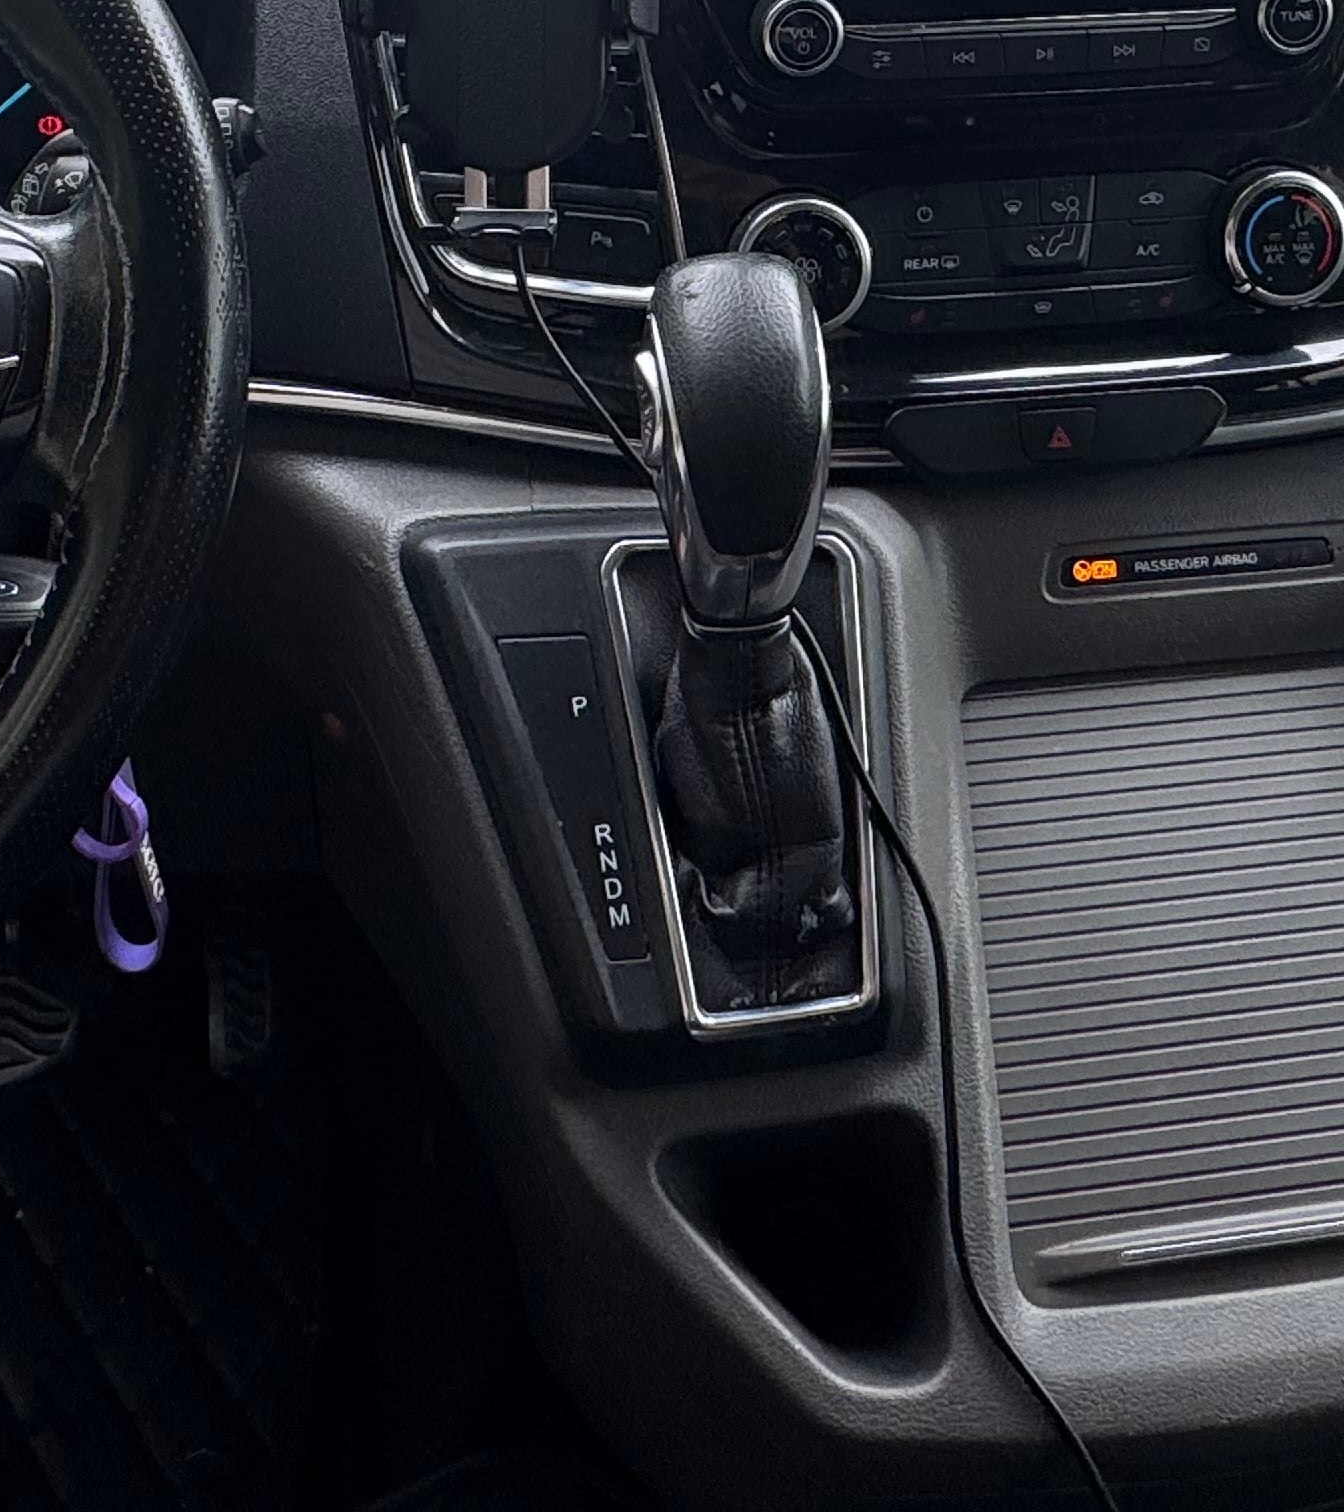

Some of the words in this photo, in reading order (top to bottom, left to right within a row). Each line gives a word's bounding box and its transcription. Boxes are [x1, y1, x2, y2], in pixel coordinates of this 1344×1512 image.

[1279, 9, 1313, 22] TUNE
[789, 26, 818, 40] VOL
[1135, 243, 1161, 257] A/C
[903, 257, 940, 271] REAR
[1134, 556, 1208, 574] PASSENGER
[1212, 551, 1259, 567] AIRBAG
[570, 695, 588, 718] P
[593, 822, 614, 846] R
[599, 850, 619, 872] N
[604, 878, 623, 900] D
[608, 903, 631, 929] M
